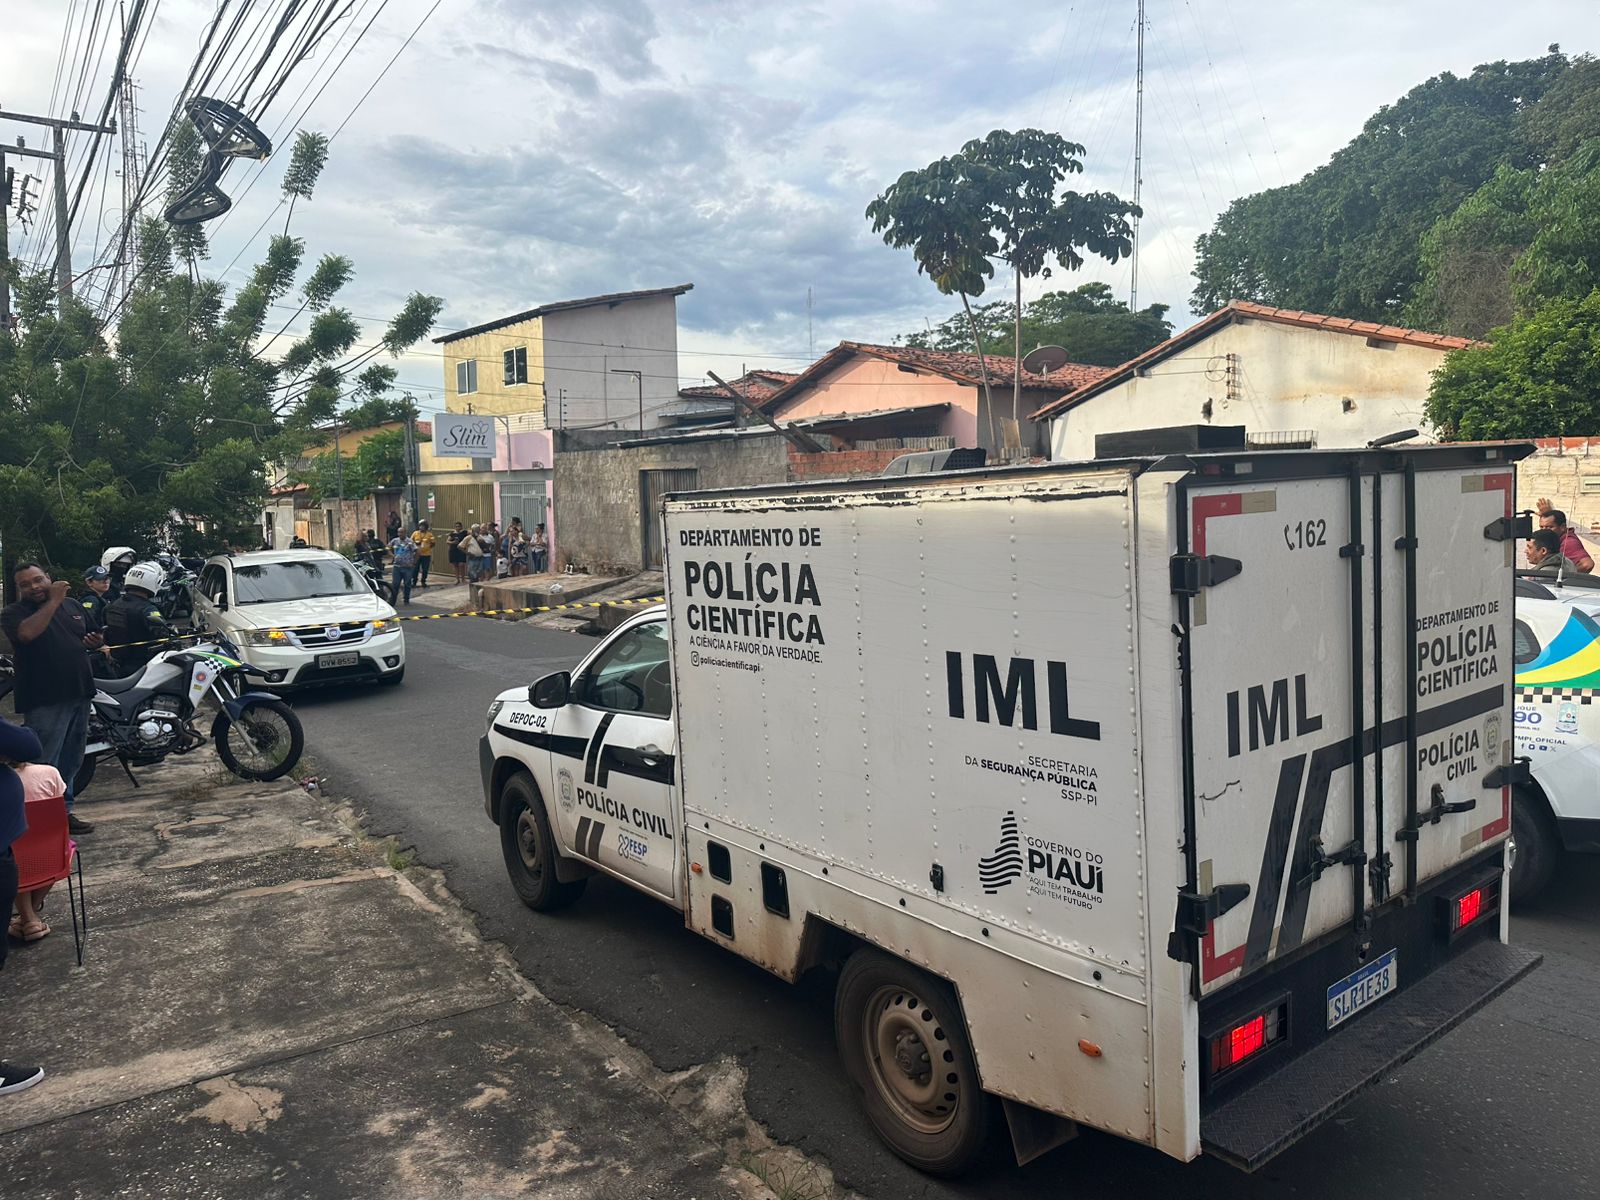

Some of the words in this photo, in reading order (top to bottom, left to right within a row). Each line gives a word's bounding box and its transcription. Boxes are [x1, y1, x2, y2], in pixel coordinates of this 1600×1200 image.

[443, 425, 486, 447] Slim
[680, 528, 793, 547] DEPARTAMENTO
[799, 528, 821, 546] DE
[1295, 519, 1326, 548] 162
[684, 552, 821, 606] POLÍCIA
[687, 603, 825, 645] CIENTÍFICA
[1416, 604, 1486, 632] DEPARTAMENTO
[1488, 601, 1499, 613] DE
[689, 636, 695, 645] A
[696, 635, 725, 650] CIÊNCIA
[727, 641, 733, 651] A
[734, 641, 760, 654] FAVOR
[763, 645, 774, 656] DA
[776, 646, 822, 663] VERDADE.
[1417, 624, 1497, 672] POLÍCIA
[700, 657, 760, 673] policiacientificapi
[1417, 655, 1497, 697] CIENTÍFICA
[946, 651, 1100, 741] IML
[510, 712, 547, 728] DEPOC-02
[1227, 673, 1323, 758] IML
[1515, 711, 1542, 724] 90
[1418, 729, 1479, 771] POLÍCIA
[965, 755, 978, 767] DA
[981, 759, 1045, 782] SEGURANÇA
[1048, 772, 1097, 792] PÚBLICA
[1028, 756, 1098, 778] SECRETARIA
[1447, 756, 1477, 781] CIVIL
[1061, 790, 1098, 806] SSP-PI
[577, 787, 629, 824] POLÍCIA
[633, 808, 672, 840] CIVIL
[629, 839, 648, 856] FESP
[1027, 837, 1081, 859] GOVERNO
[1086, 852, 1103, 864] DO
[1028, 848, 1103, 894] PIAUÍ
[1030, 877, 1046, 888] AQUI
[1047, 881, 1061, 892] TEM
[1063, 886, 1103, 903] TRABALHO
[1030, 886, 1047, 897] AQUI
[1048, 890, 1061, 901] TEM
[1063, 896, 1093, 910] FUTURO
[1334, 968, 1389, 1021] SLR1E38
